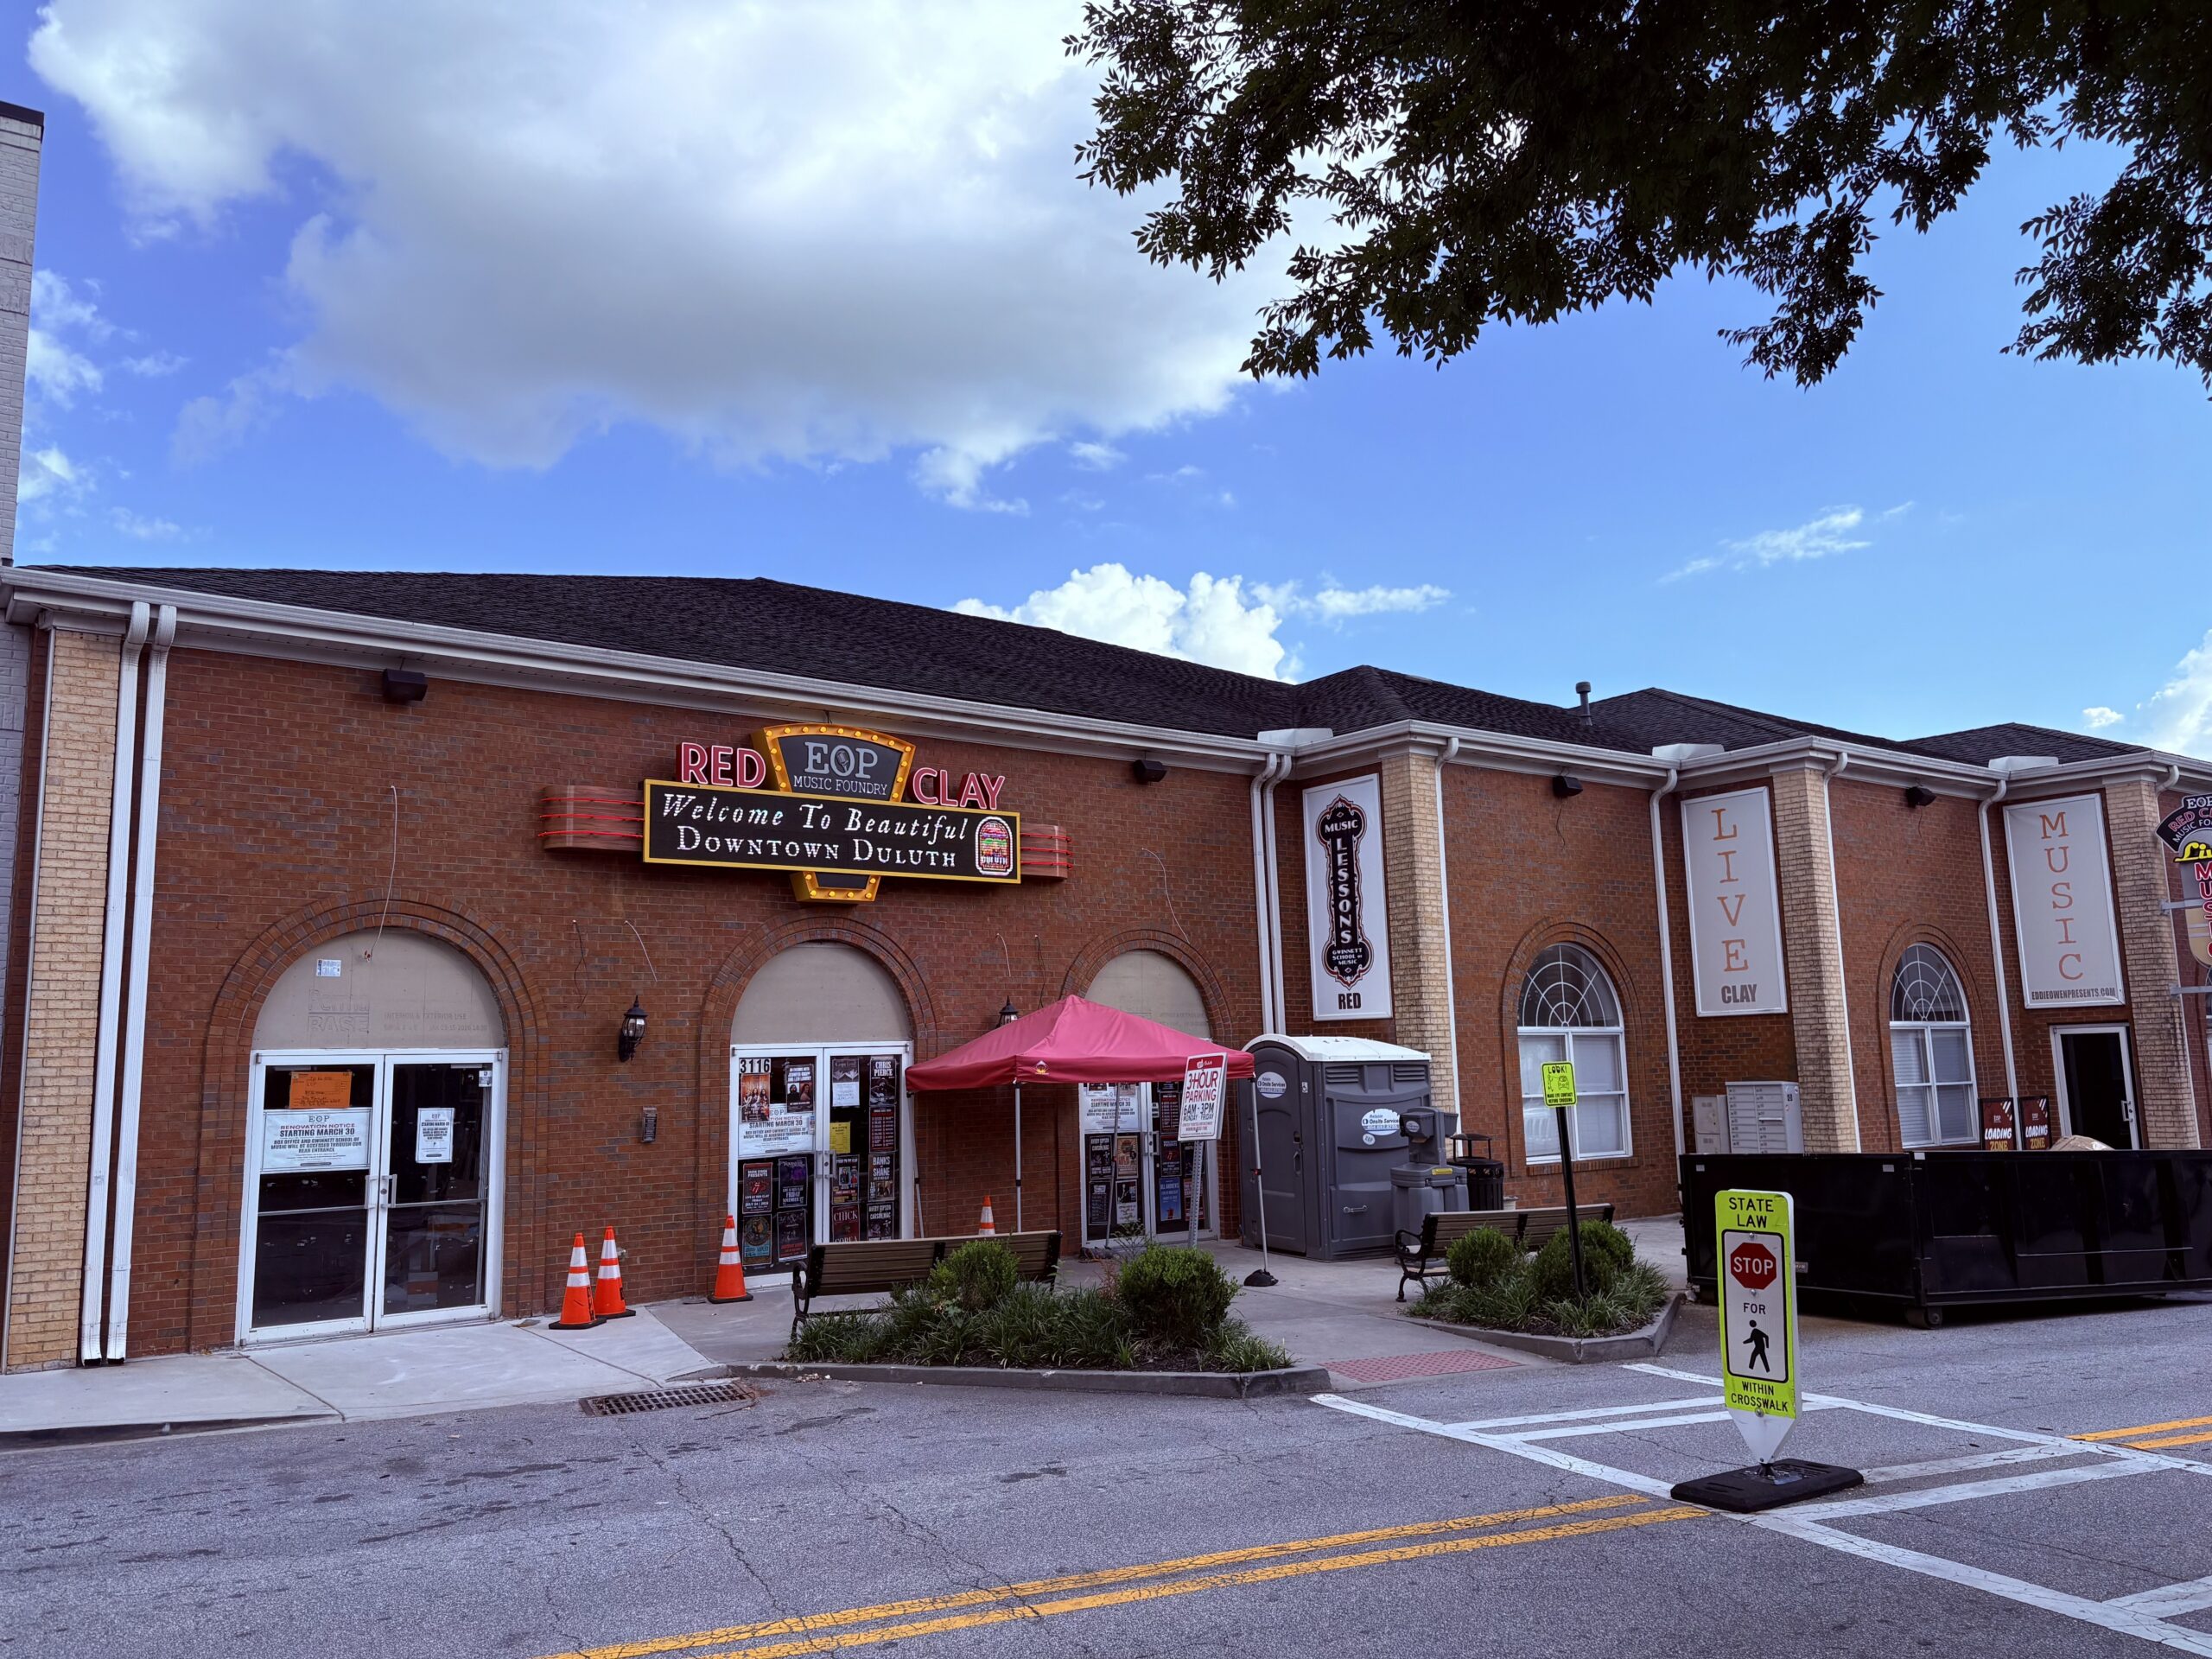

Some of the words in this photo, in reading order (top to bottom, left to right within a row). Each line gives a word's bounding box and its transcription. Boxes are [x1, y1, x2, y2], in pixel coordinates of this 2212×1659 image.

[681, 742, 766, 788] RED
[804, 741, 878, 779] EOP
[793, 775, 831, 791] MUSIC
[836, 779, 887, 796] FOUNDRY
[912, 767, 1005, 810] CLAY
[663, 793, 784, 825] Welcome
[799, 804, 830, 830] To
[845, 808, 968, 845] Beautiful
[1325, 819, 1358, 833] MUSIC
[2168, 811, 2195, 832] RED
[2172, 822, 2196, 842] MUSIC
[1337, 837, 1353, 944] LESSONS
[1711, 808, 1749, 972] LIVE
[2039, 811, 2083, 980] MUSIC
[1338, 993, 1362, 1009] RED
[1721, 984, 1757, 1004] CLAY
[740, 1059, 770, 1073] 3116
[1187, 1071, 1218, 1090] 3-HOUR
[1185, 1089, 1217, 1103] PARKING
[1183, 1104, 1197, 1116] 6AM
[1201, 1103, 1215, 1114] 3PM
[280, 1128, 315, 1137] STARTING
[1985, 1128, 2012, 1140] LOADING
[2025, 1124, 2048, 1137] LOADING
[1990, 1141, 2008, 1151] ZONE
[2031, 1137, 2045, 1149] ZONE
[873, 1156, 891, 1166] BANKS
[873, 1167, 890, 1177] SHANE
[1729, 1197, 1774, 1212] STATE
[834, 1210, 858, 1221] CHICK
[1737, 1213, 1768, 1228] LAW
[1733, 1256, 1774, 1275] STOP
[1743, 1302, 1766, 1314] FOR
[1741, 1381, 1775, 1395] WITHIN
[1732, 1392, 1788, 1412] CROSSWALK
